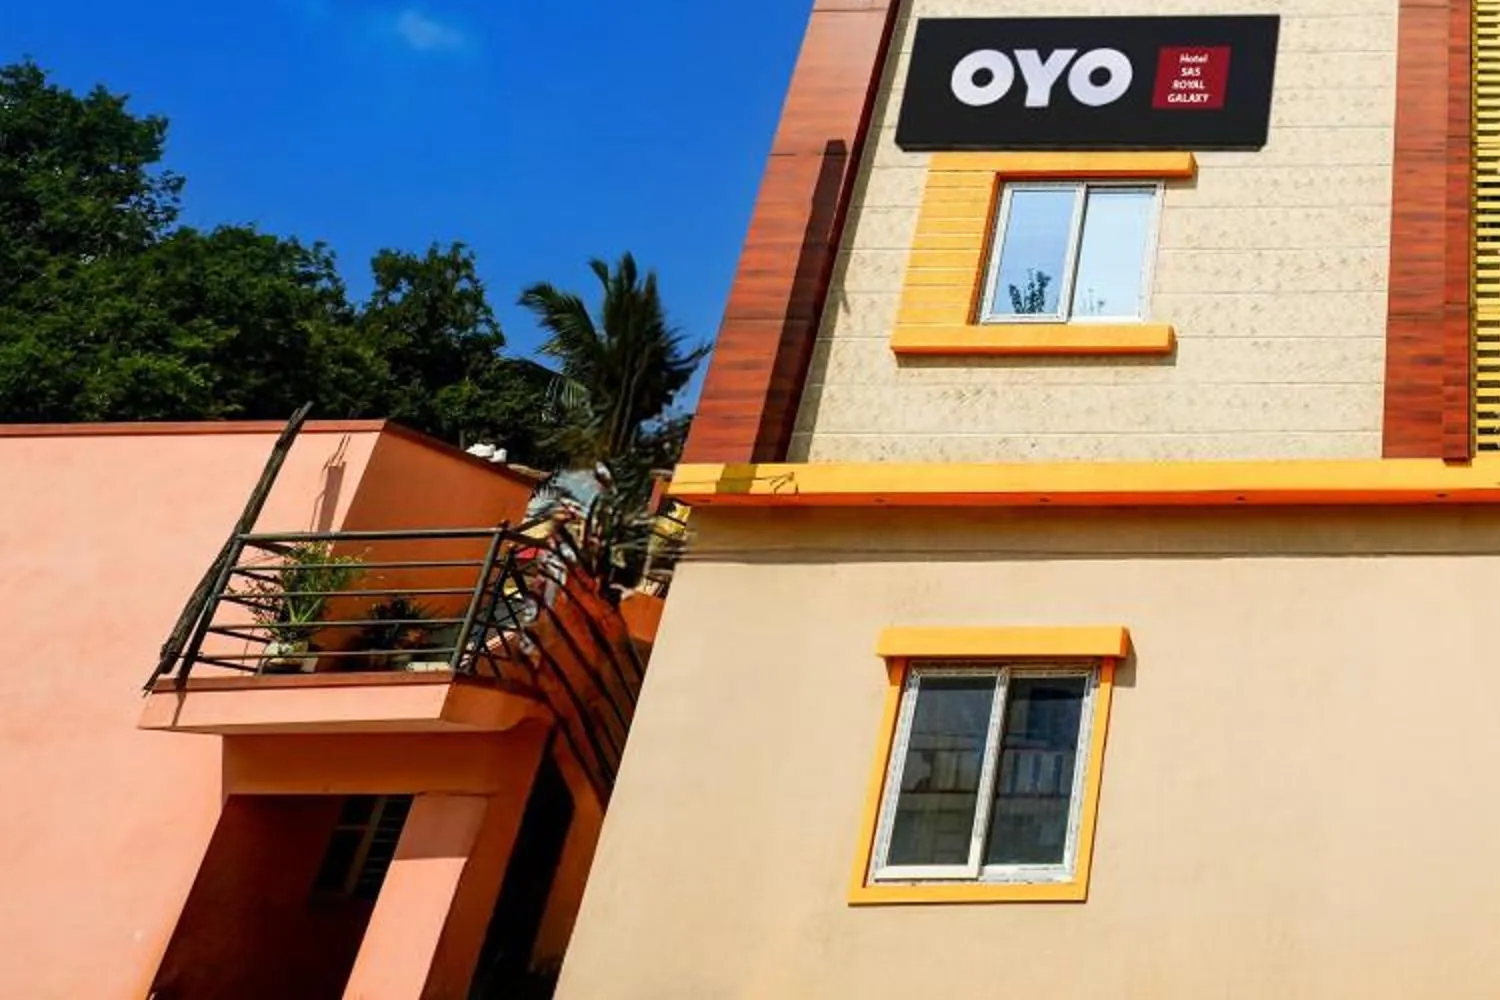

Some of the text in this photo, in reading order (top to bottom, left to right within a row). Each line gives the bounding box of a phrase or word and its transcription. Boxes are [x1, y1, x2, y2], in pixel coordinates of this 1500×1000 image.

[951, 47, 1133, 108] OYO
[1172, 79, 1206, 90] ROYAL
[1167, 93, 1209, 103] GALAXY
